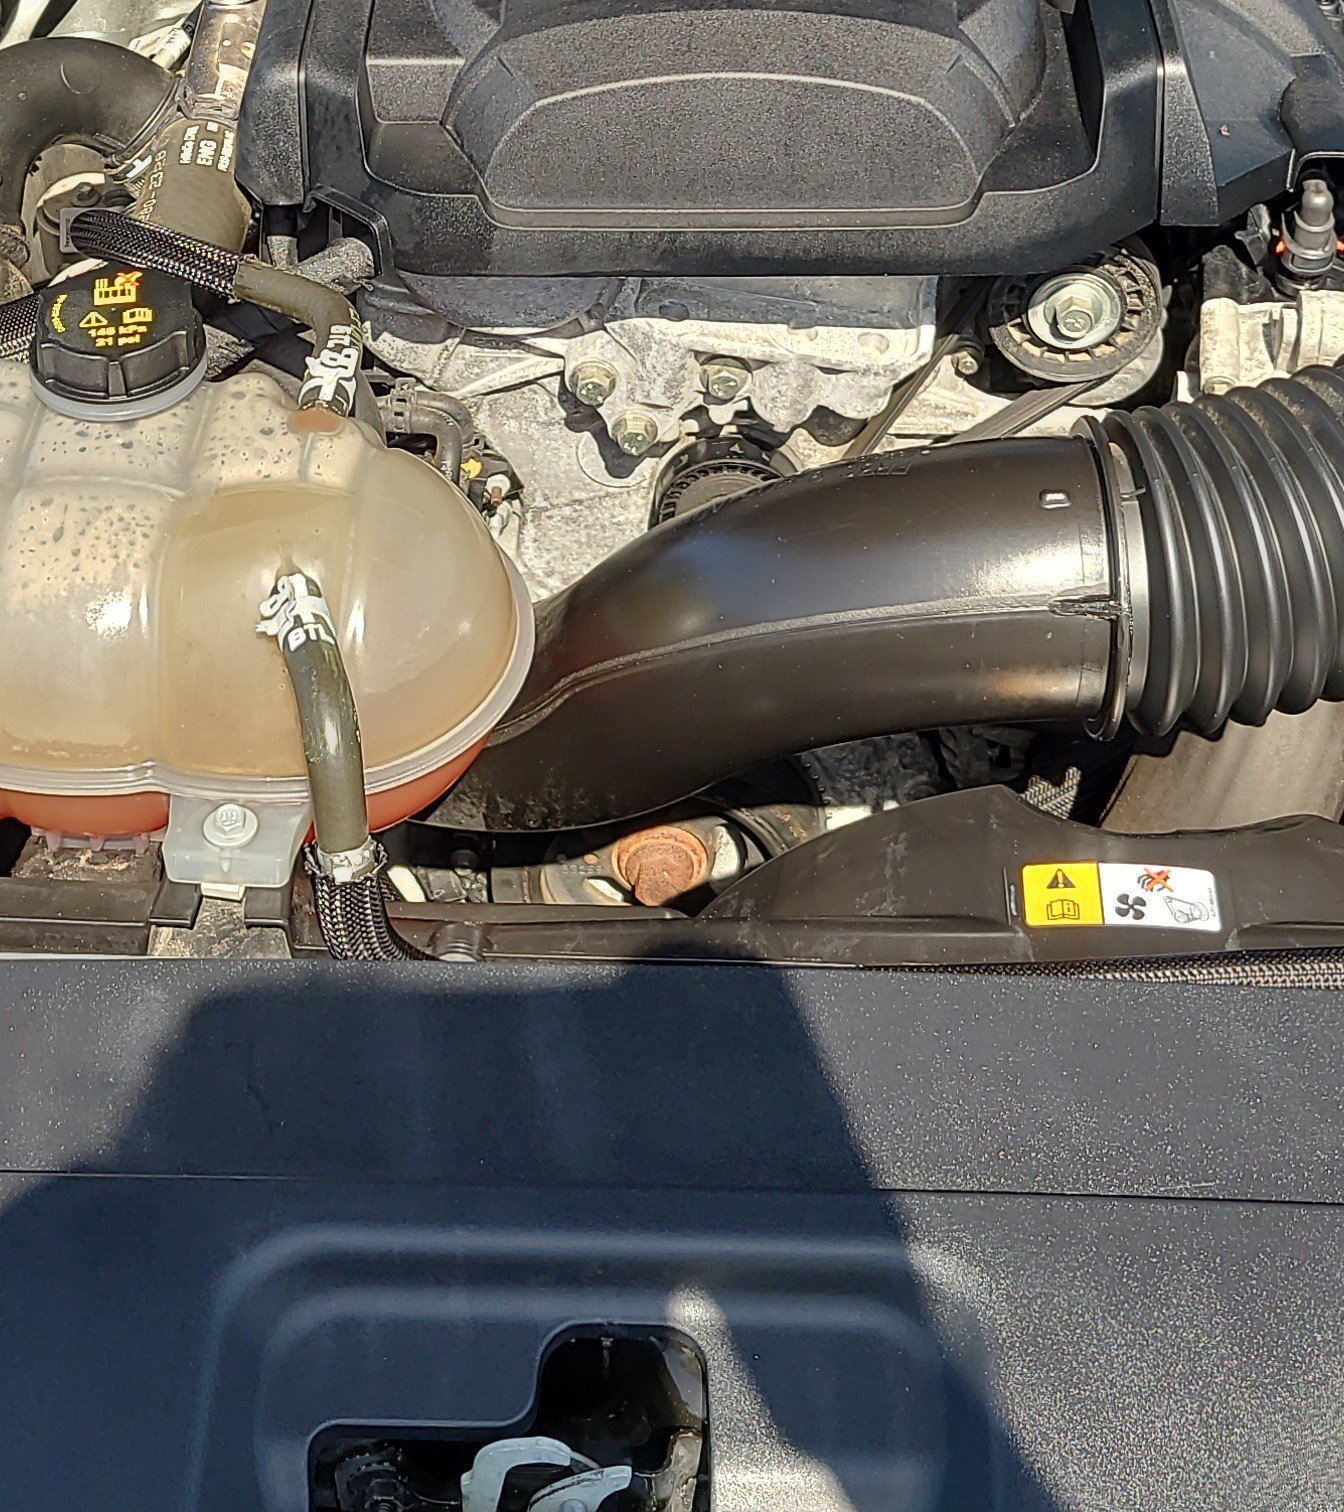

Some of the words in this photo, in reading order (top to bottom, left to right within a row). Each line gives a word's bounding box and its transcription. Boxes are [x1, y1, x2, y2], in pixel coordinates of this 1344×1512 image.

[196, 139, 217, 166] ENG
[94, 336, 114, 348] 21
[117, 334, 141, 347] psi
[287, 623, 336, 652] BTL
